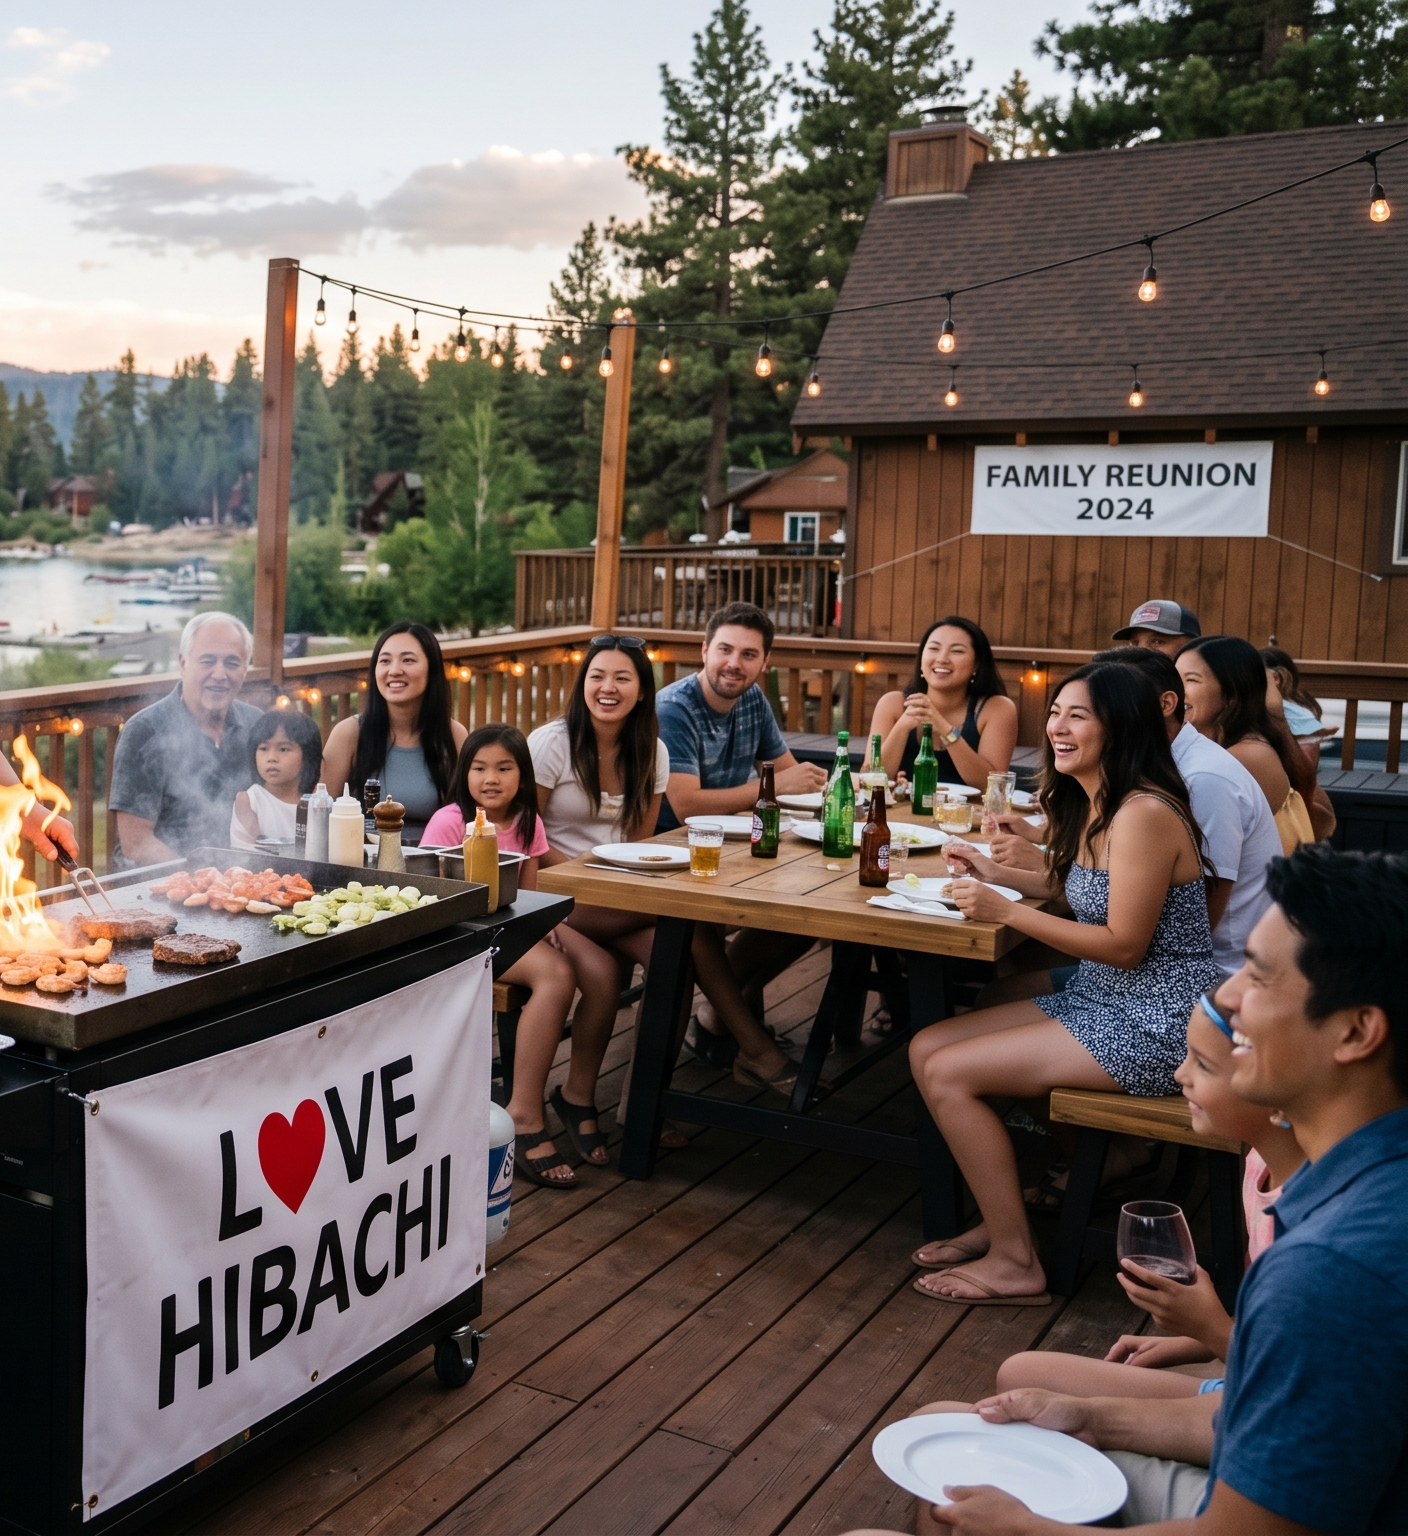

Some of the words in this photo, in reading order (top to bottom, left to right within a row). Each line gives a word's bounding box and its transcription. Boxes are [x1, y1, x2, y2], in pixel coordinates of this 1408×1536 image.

[986, 464, 1097, 488] FAMILY
[1105, 462, 1257, 487] REUNION
[1076, 497, 1155, 521] 2024
[158, 1153, 452, 1411] HIBACHI
